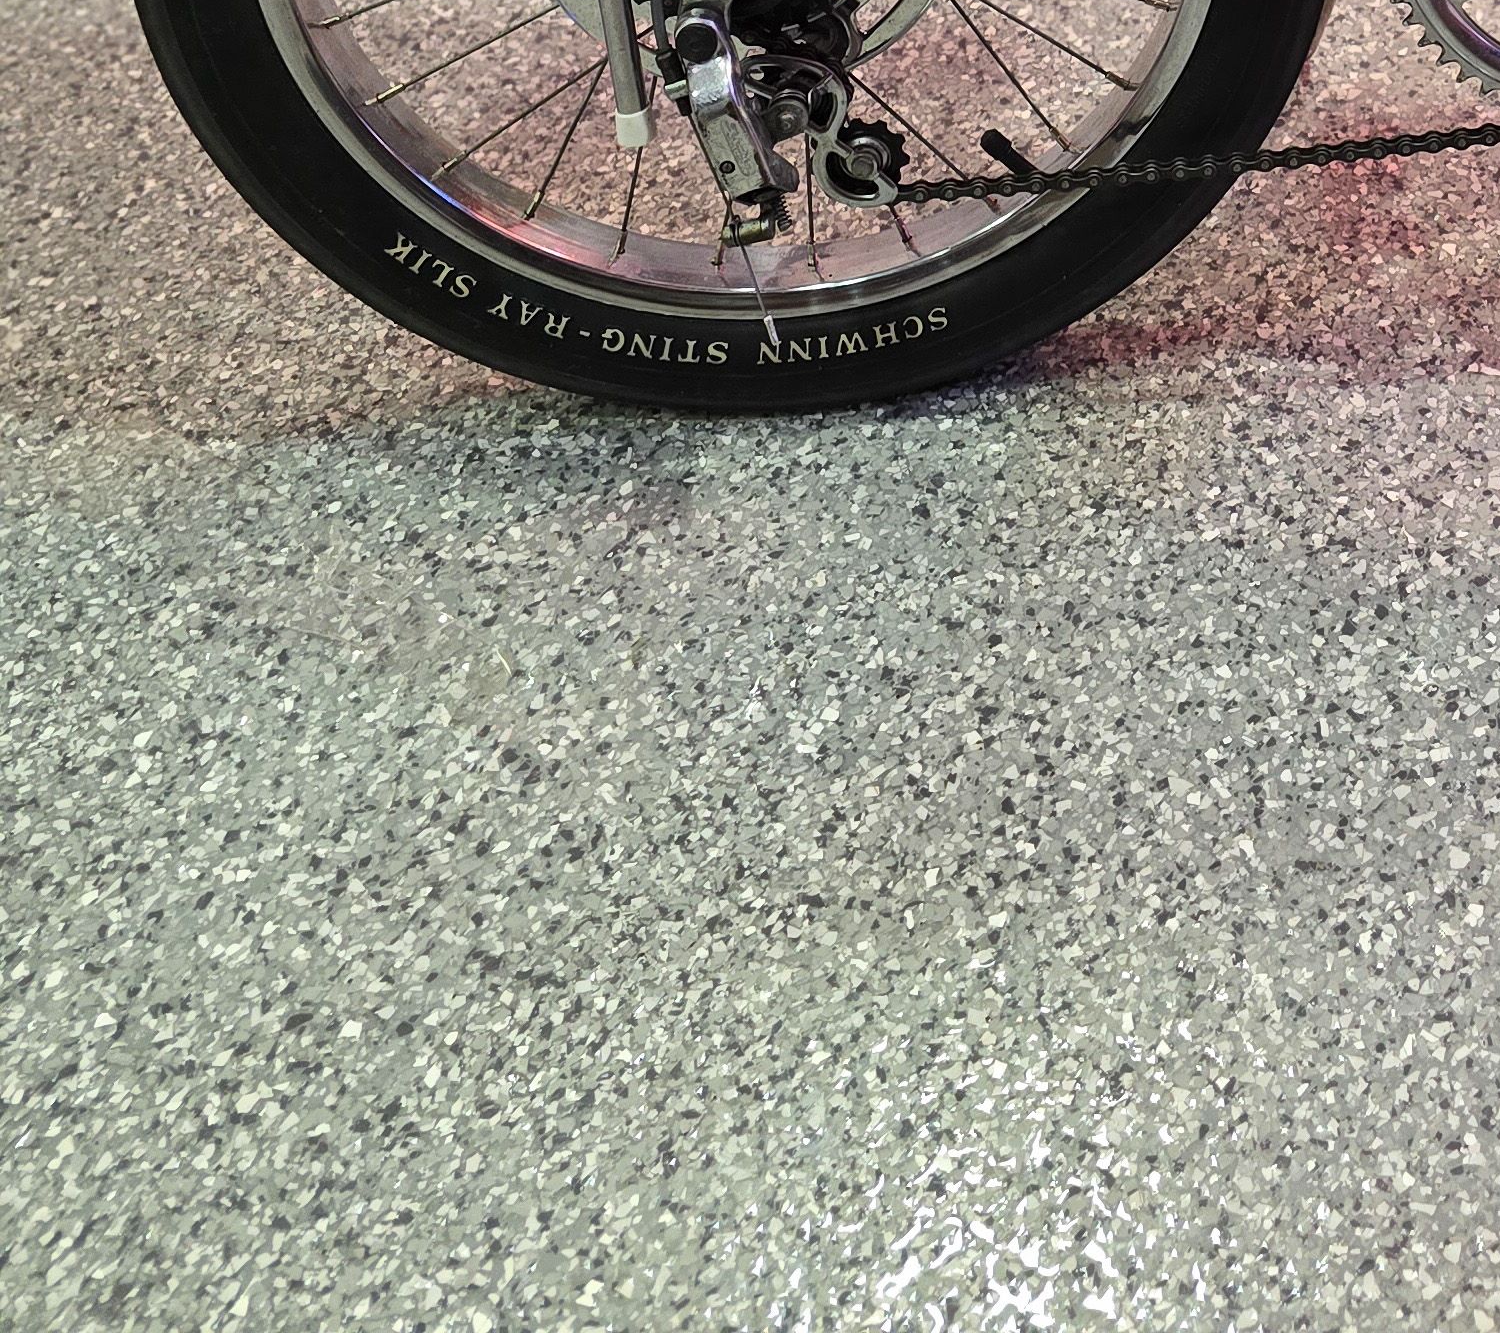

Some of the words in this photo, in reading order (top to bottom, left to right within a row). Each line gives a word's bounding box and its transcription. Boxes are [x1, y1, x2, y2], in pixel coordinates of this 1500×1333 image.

[384, 232, 478, 299] SLIK
[487, 292, 729, 365] STING-RAY
[756, 307, 949, 365] SCHWINN
